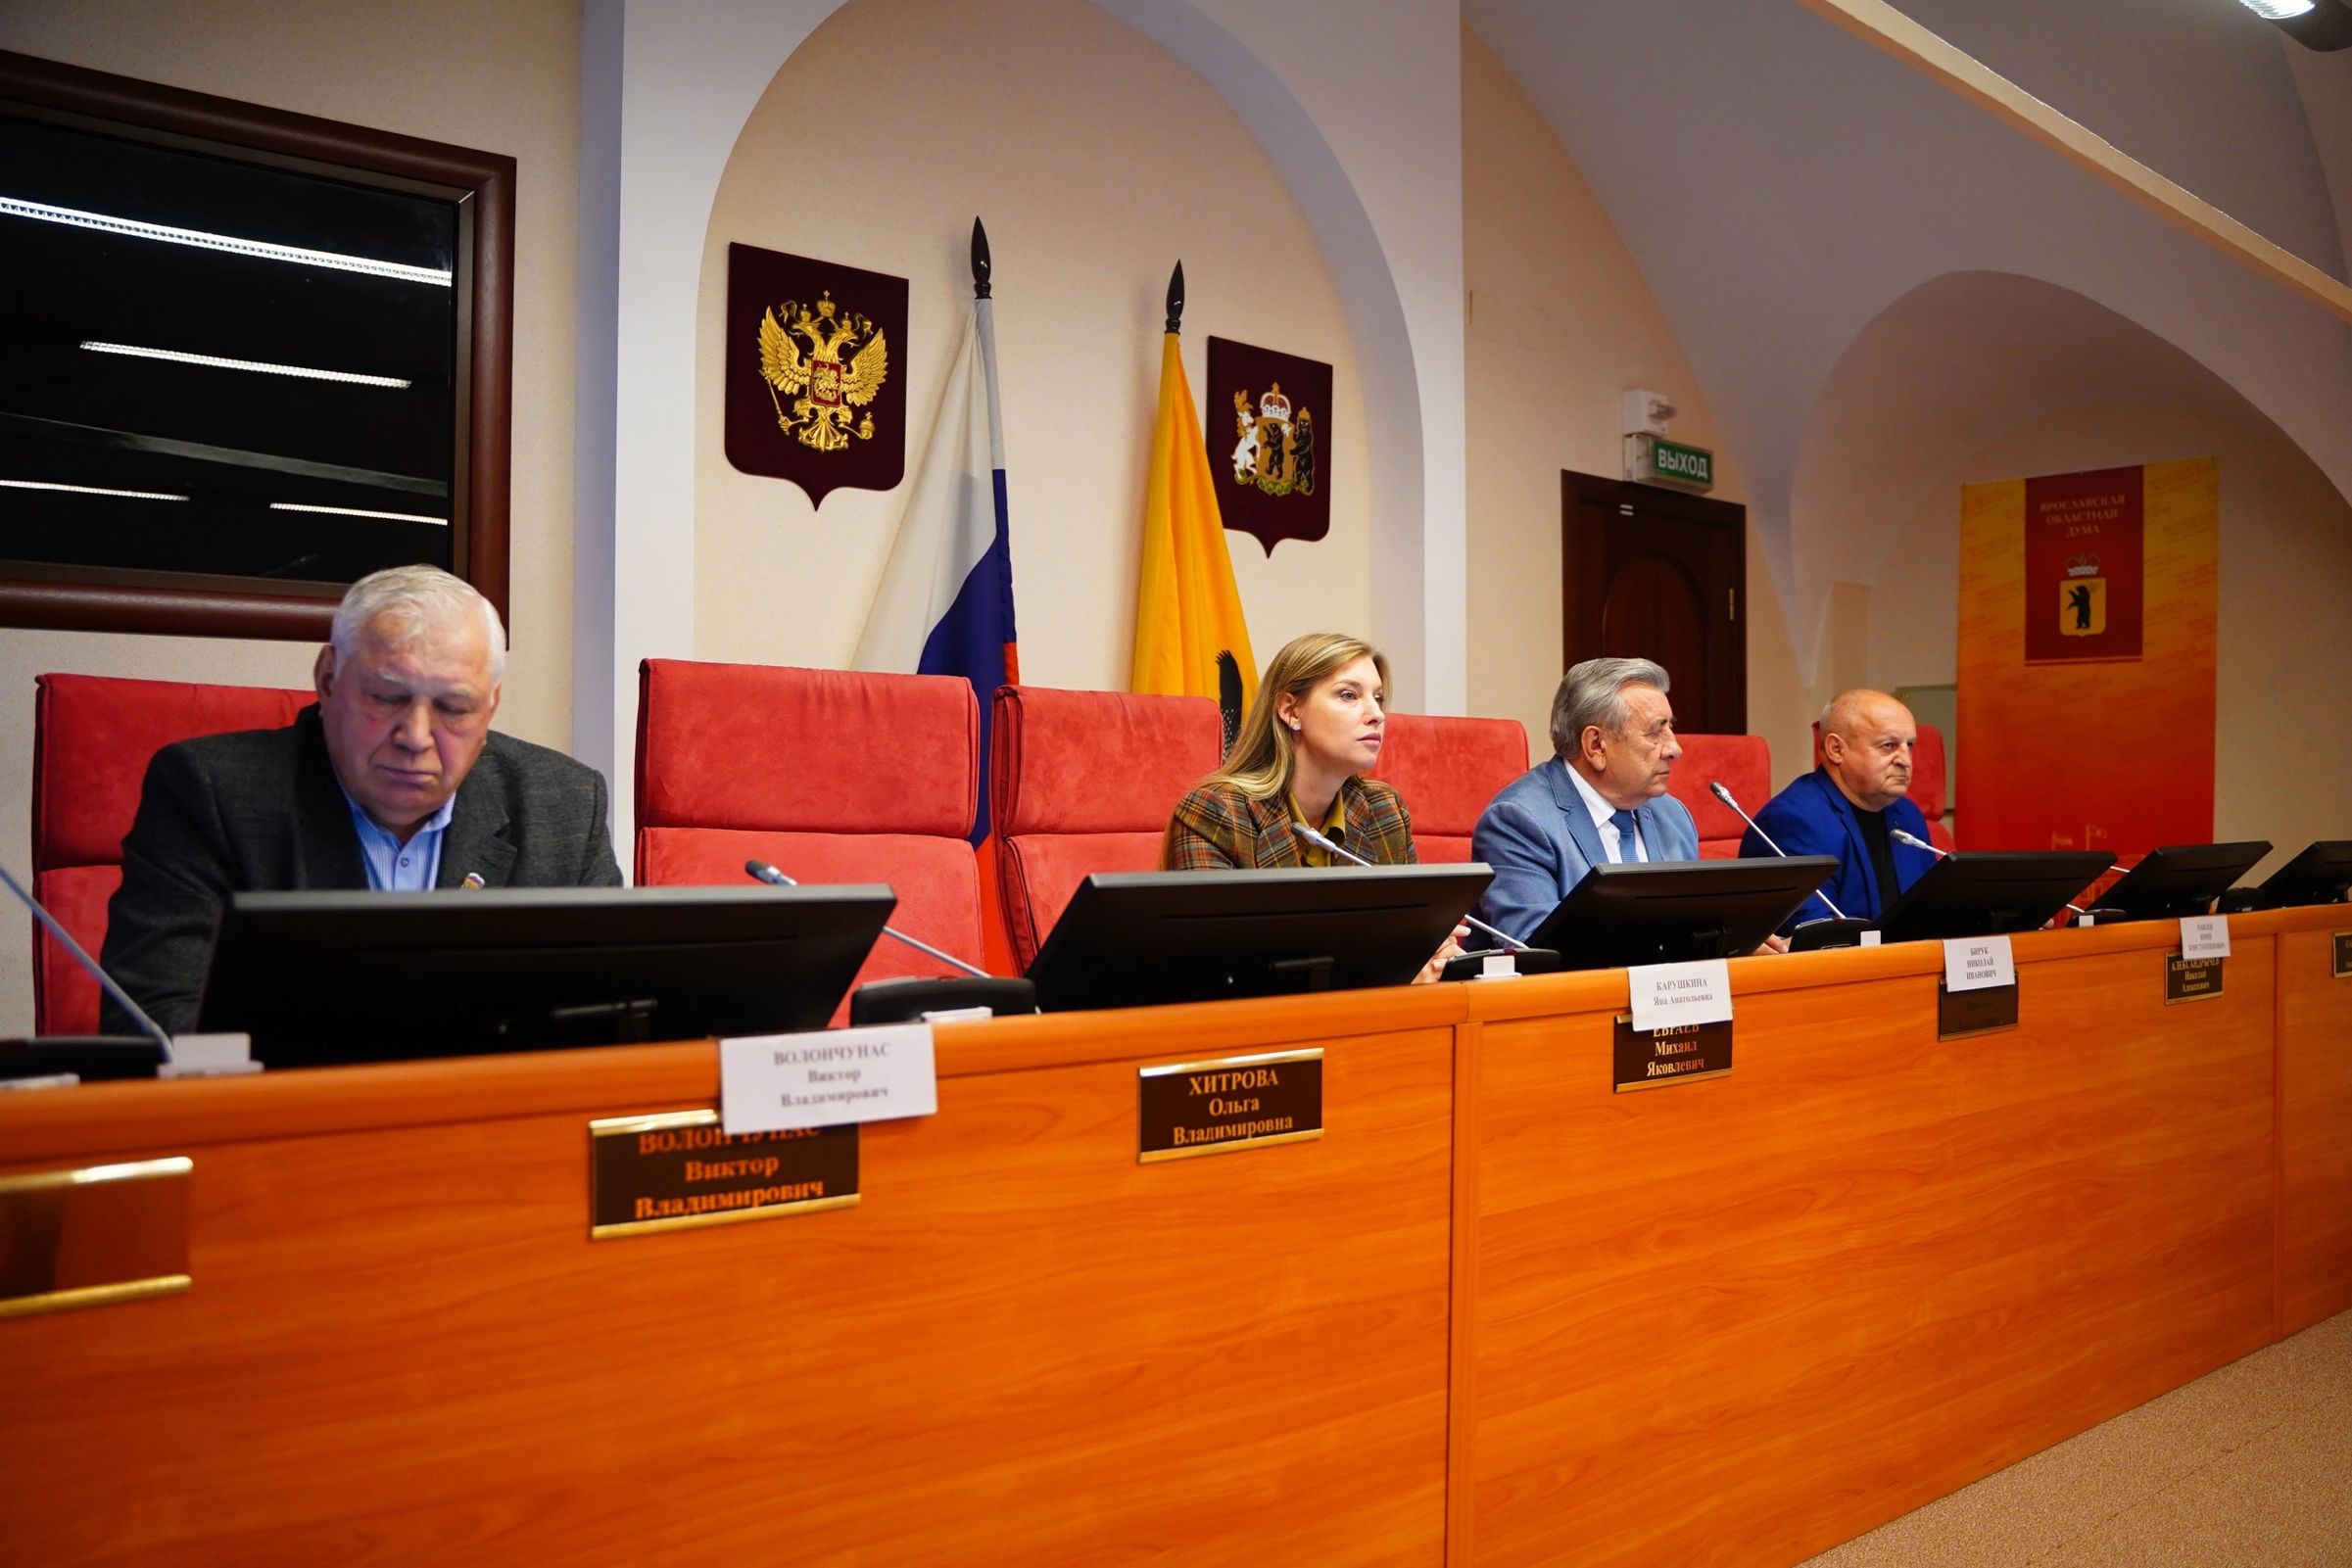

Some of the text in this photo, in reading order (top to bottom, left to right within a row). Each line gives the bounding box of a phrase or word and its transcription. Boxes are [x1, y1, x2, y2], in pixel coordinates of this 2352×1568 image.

[1657, 448, 1708, 480] ВЫХОД
[2039, 494, 2126, 512] ЯРОСЛАВСКАЯ
[2045, 508, 2119, 525] ОБЛАСТНАЯ
[2065, 525, 2100, 538] ДУМА
[1970, 947, 1989, 956] БИРУК
[1966, 957, 1994, 968] НИКОЛАЙ
[1966, 970, 1997, 980] ИВАНОВИЧ
[1656, 977, 1708, 992] КАРУШКИНА
[1654, 993, 1713, 1006] Яна Анатольевна
[773, 1042, 892, 1066] ВОЛОНЧУНАС
[1655, 1040, 1698, 1057] Михаил
[1647, 1059, 1704, 1076] Яковлевич
[807, 1068, 862, 1085] Виктор
[1188, 1069, 1279, 1096] ХИТРОВА
[780, 1086, 889, 1108] Владимирович
[1208, 1098, 1261, 1117] Ольга
[1173, 1117, 1294, 1146] Владимировна
[685, 1156, 781, 1182] Виктор
[635, 1181, 825, 1219] Владимирович
